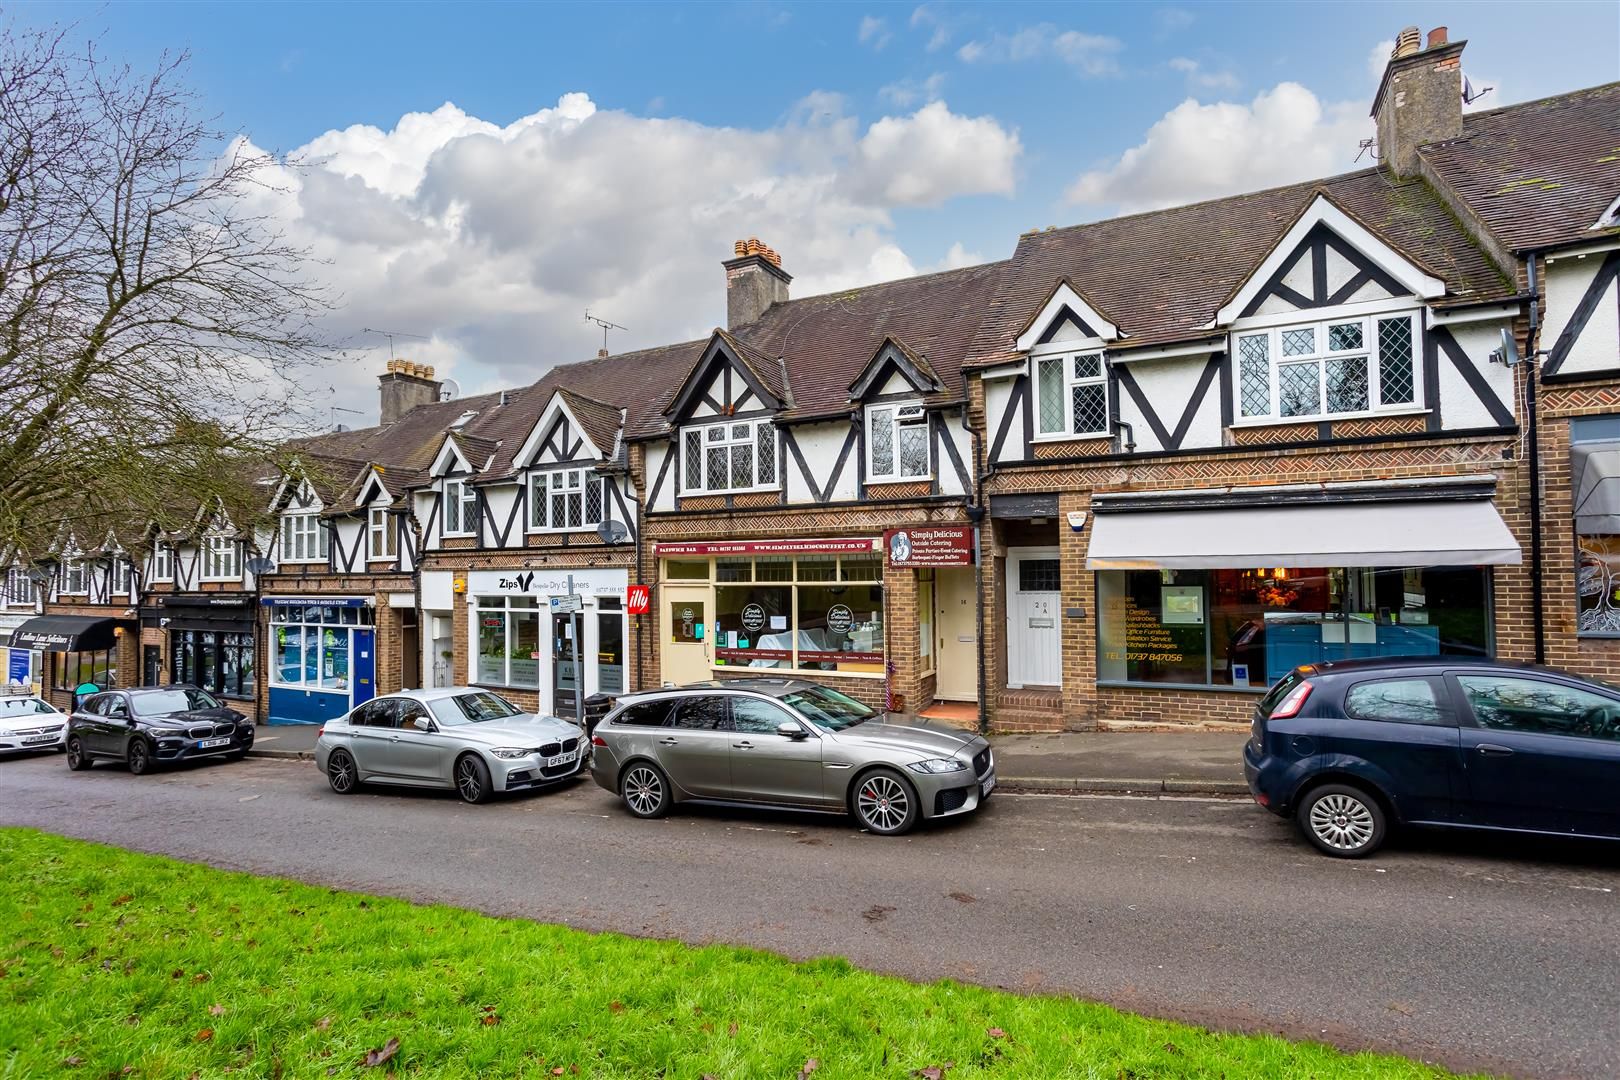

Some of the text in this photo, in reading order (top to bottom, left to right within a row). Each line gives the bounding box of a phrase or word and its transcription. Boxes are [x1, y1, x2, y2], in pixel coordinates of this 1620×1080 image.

[911, 530, 963, 540] Simply Delicious
[499, 578, 518, 589] Zips
[550, 581, 560, 590] Dry
[629, 590, 648, 611] illy
[1148, 642, 1178, 650] Packages
[1125, 653, 1148, 661] 01737
[1149, 653, 1183, 662] 847056
